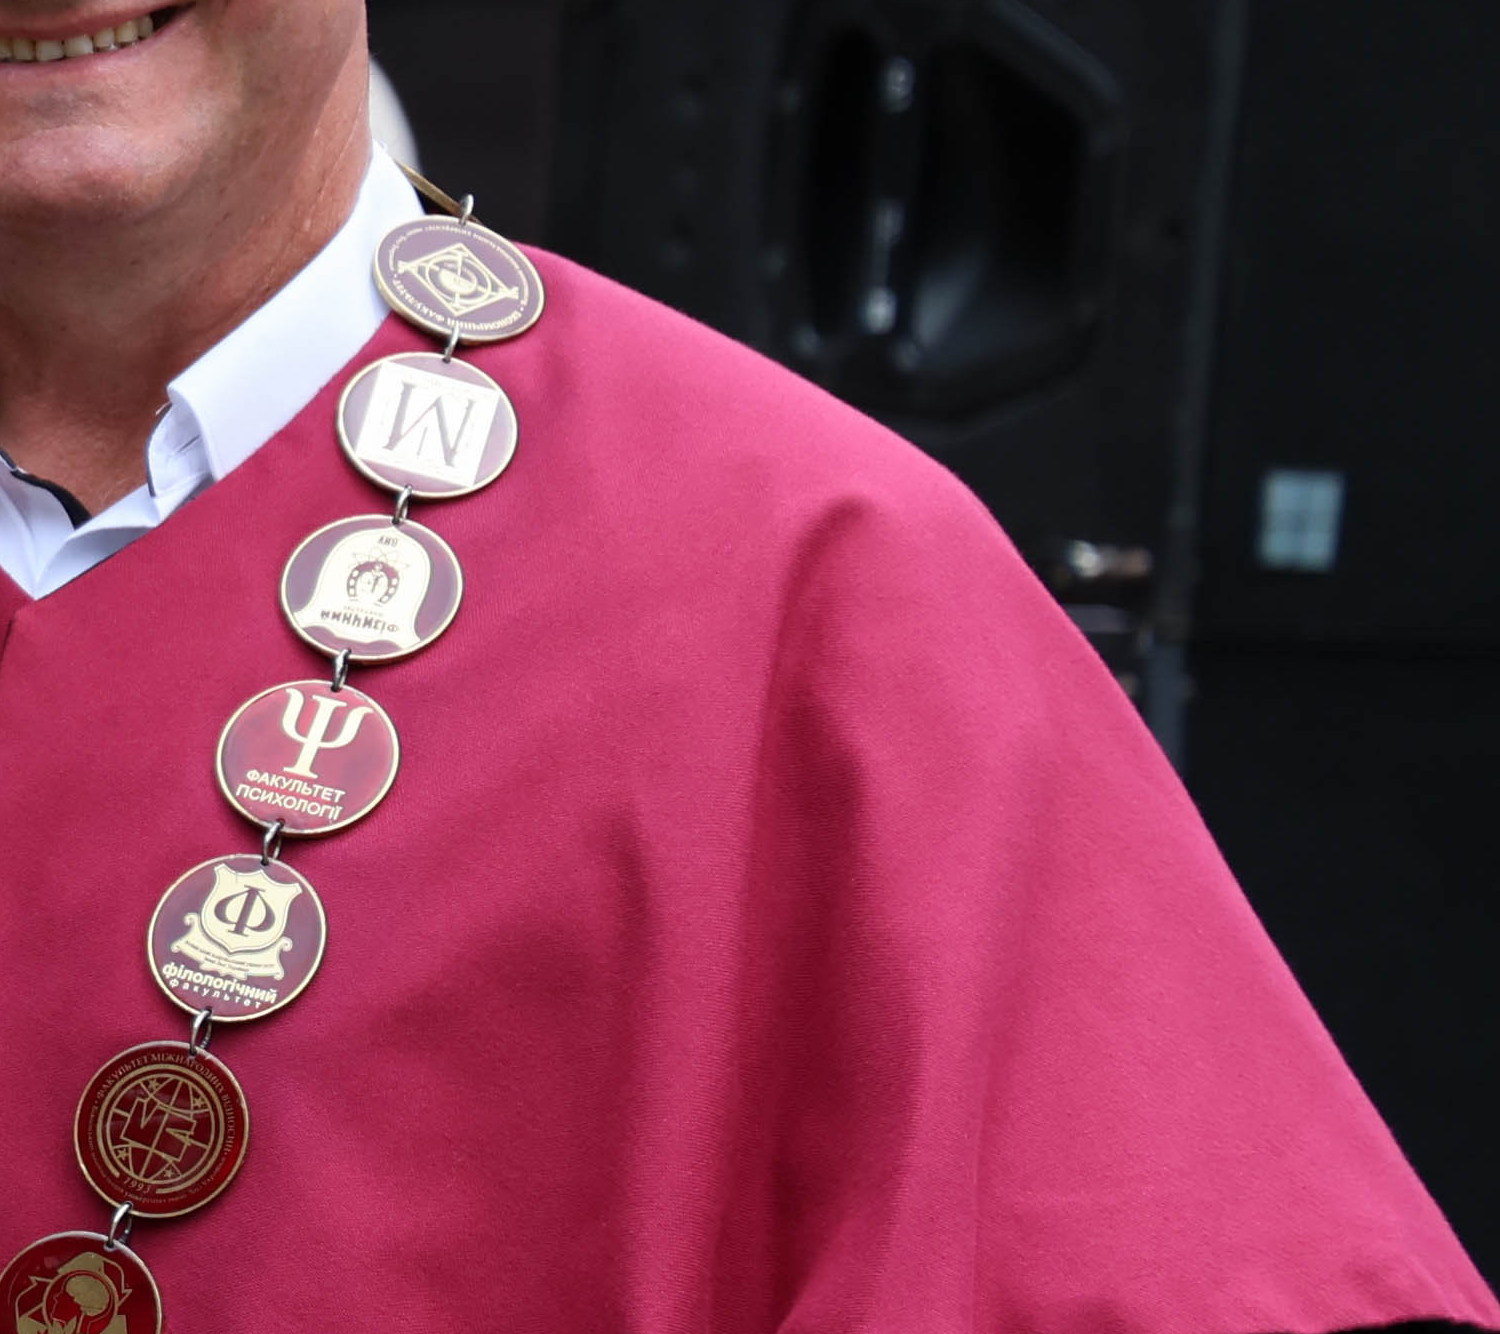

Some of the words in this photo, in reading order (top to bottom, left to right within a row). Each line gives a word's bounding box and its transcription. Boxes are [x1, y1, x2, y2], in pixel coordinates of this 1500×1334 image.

[235, 784, 344, 820] ПСИХОЛОГІЇ
[246, 769, 347, 804] ФАКУЛЬТЕТ
[161, 961, 279, 1004] філологічний
[168, 977, 264, 1009] факультет
